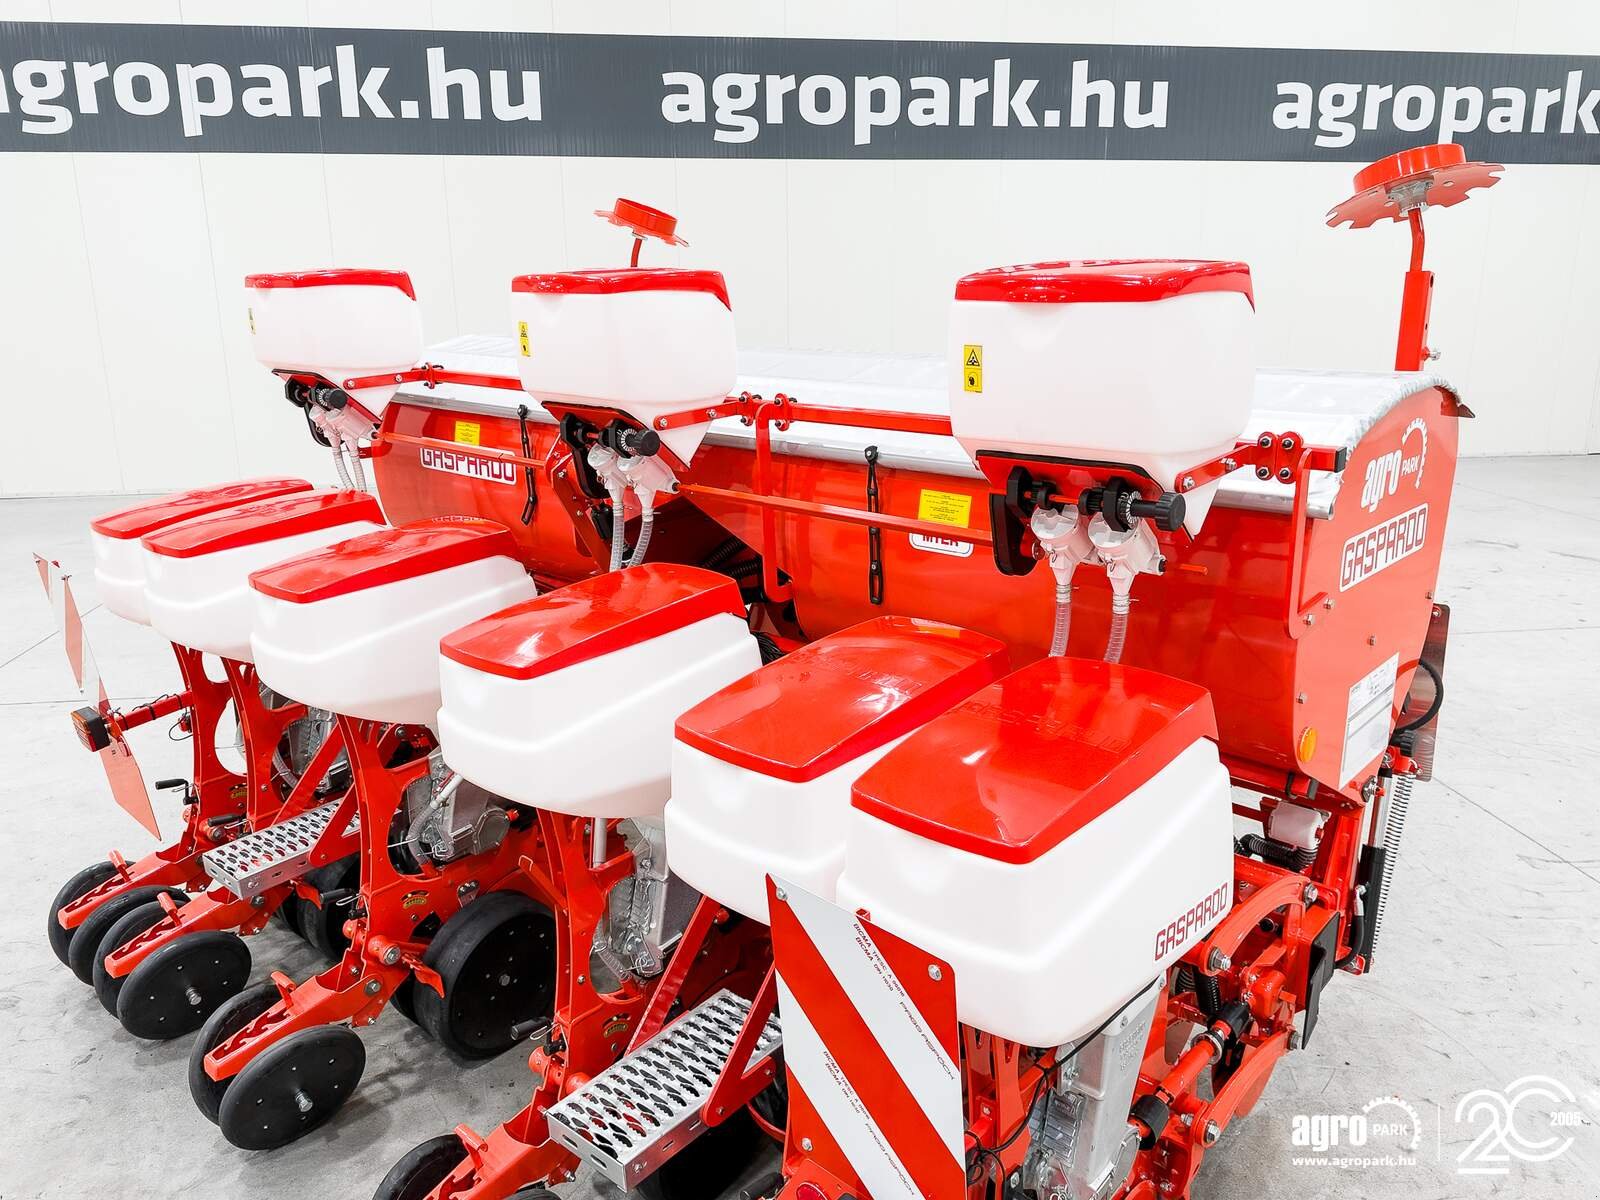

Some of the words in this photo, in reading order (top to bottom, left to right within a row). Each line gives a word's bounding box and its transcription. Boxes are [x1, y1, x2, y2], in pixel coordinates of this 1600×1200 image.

[0, 44, 542, 137] gropark.hu
[661, 58, 1169, 146] agropark.hu
[1272, 70, 1600, 147] agropark
[421, 448, 515, 482] GASPARDO
[1361, 449, 1403, 513] agro
[1401, 454, 1421, 477] PARK
[1341, 507, 1427, 588] GASPARDO
[1154, 882, 1228, 961] GASPARDO
